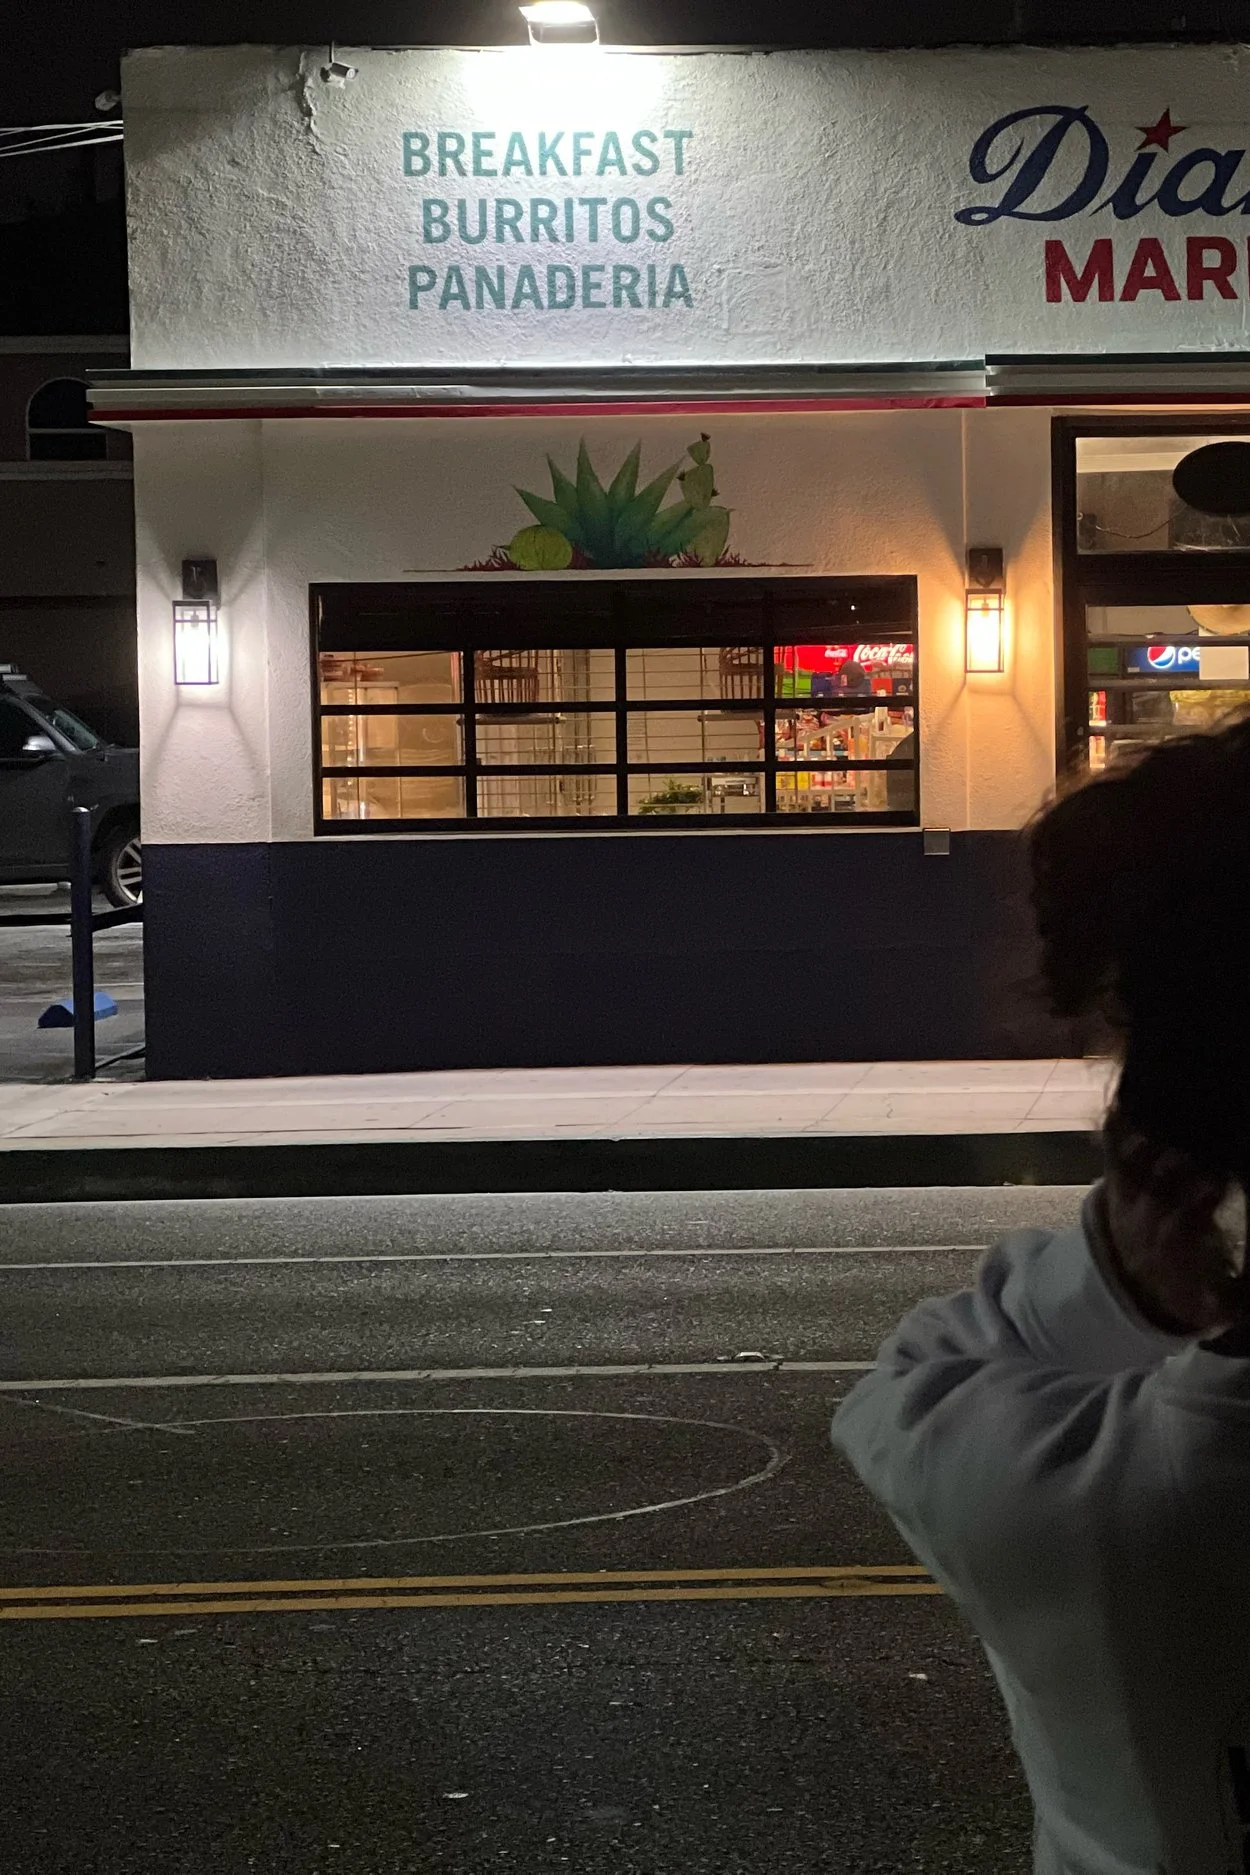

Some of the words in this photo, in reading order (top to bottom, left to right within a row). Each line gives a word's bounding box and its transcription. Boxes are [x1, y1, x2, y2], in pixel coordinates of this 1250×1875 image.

[402, 129, 693, 178] BREAKFAST
[422, 195, 676, 245] BURRITOS
[407, 263, 695, 311] PANADERIA
